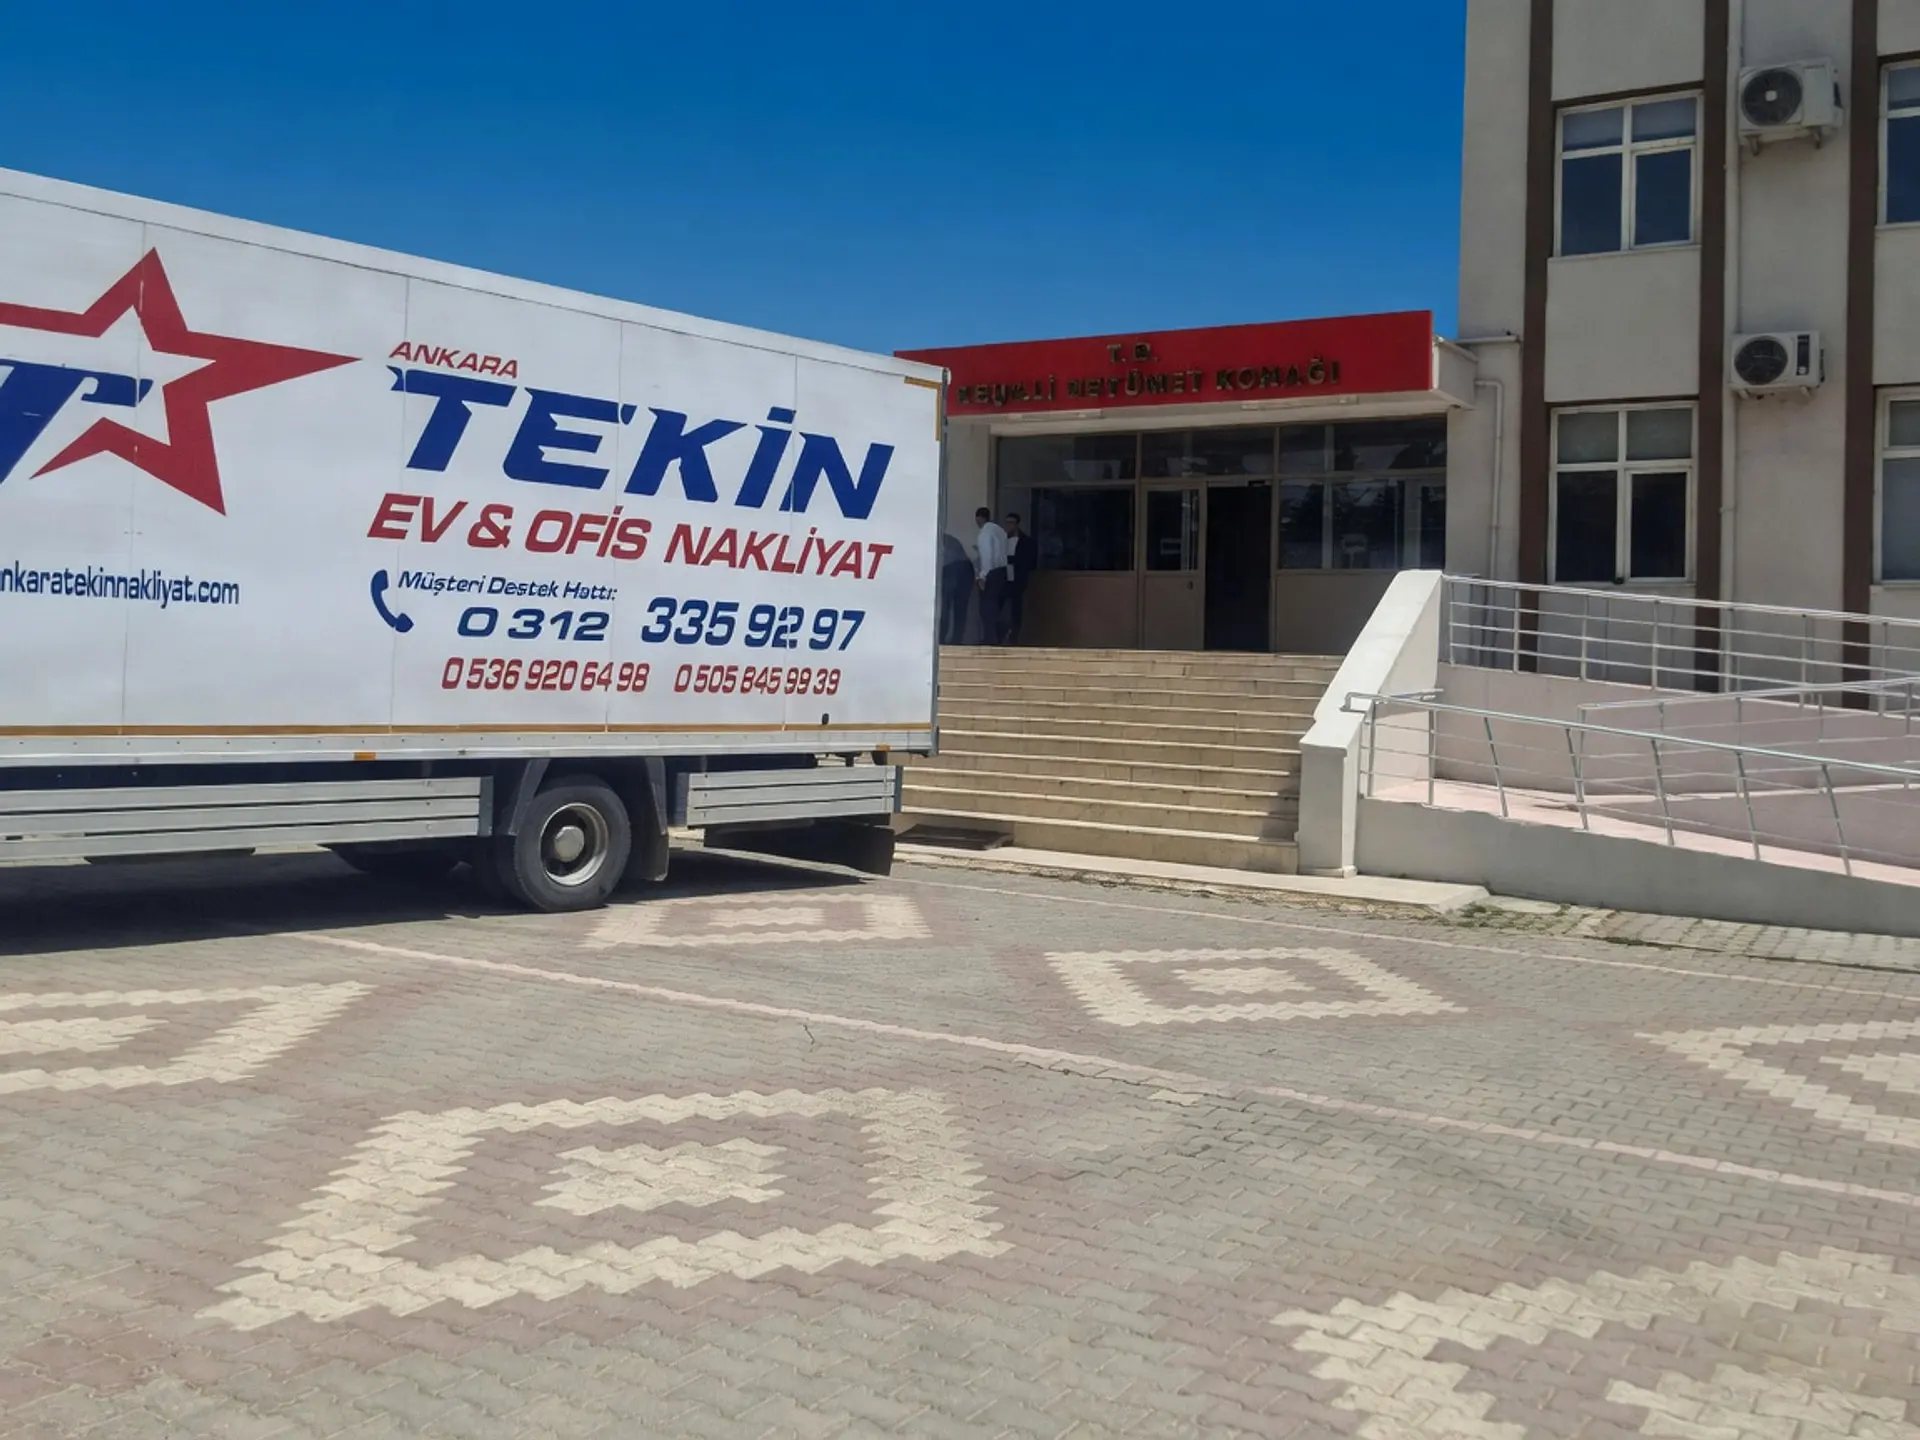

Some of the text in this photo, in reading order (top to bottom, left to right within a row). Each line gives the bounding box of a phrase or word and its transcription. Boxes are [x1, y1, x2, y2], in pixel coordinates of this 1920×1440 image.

[389, 341, 518, 379] ANKARA
[386, 364, 895, 520] TEKİN
[367, 493, 894, 580] EV & OFİS NAKLİYAT
[0, 560, 240, 609] nkaratekinnakliyat.com
[398, 571, 618, 601] Müşteri Destek Hattı:
[457, 596, 867, 651] 0 312 335 92 97
[441, 656, 842, 695] 0 536 920 64 98 0 505 845 99 39
